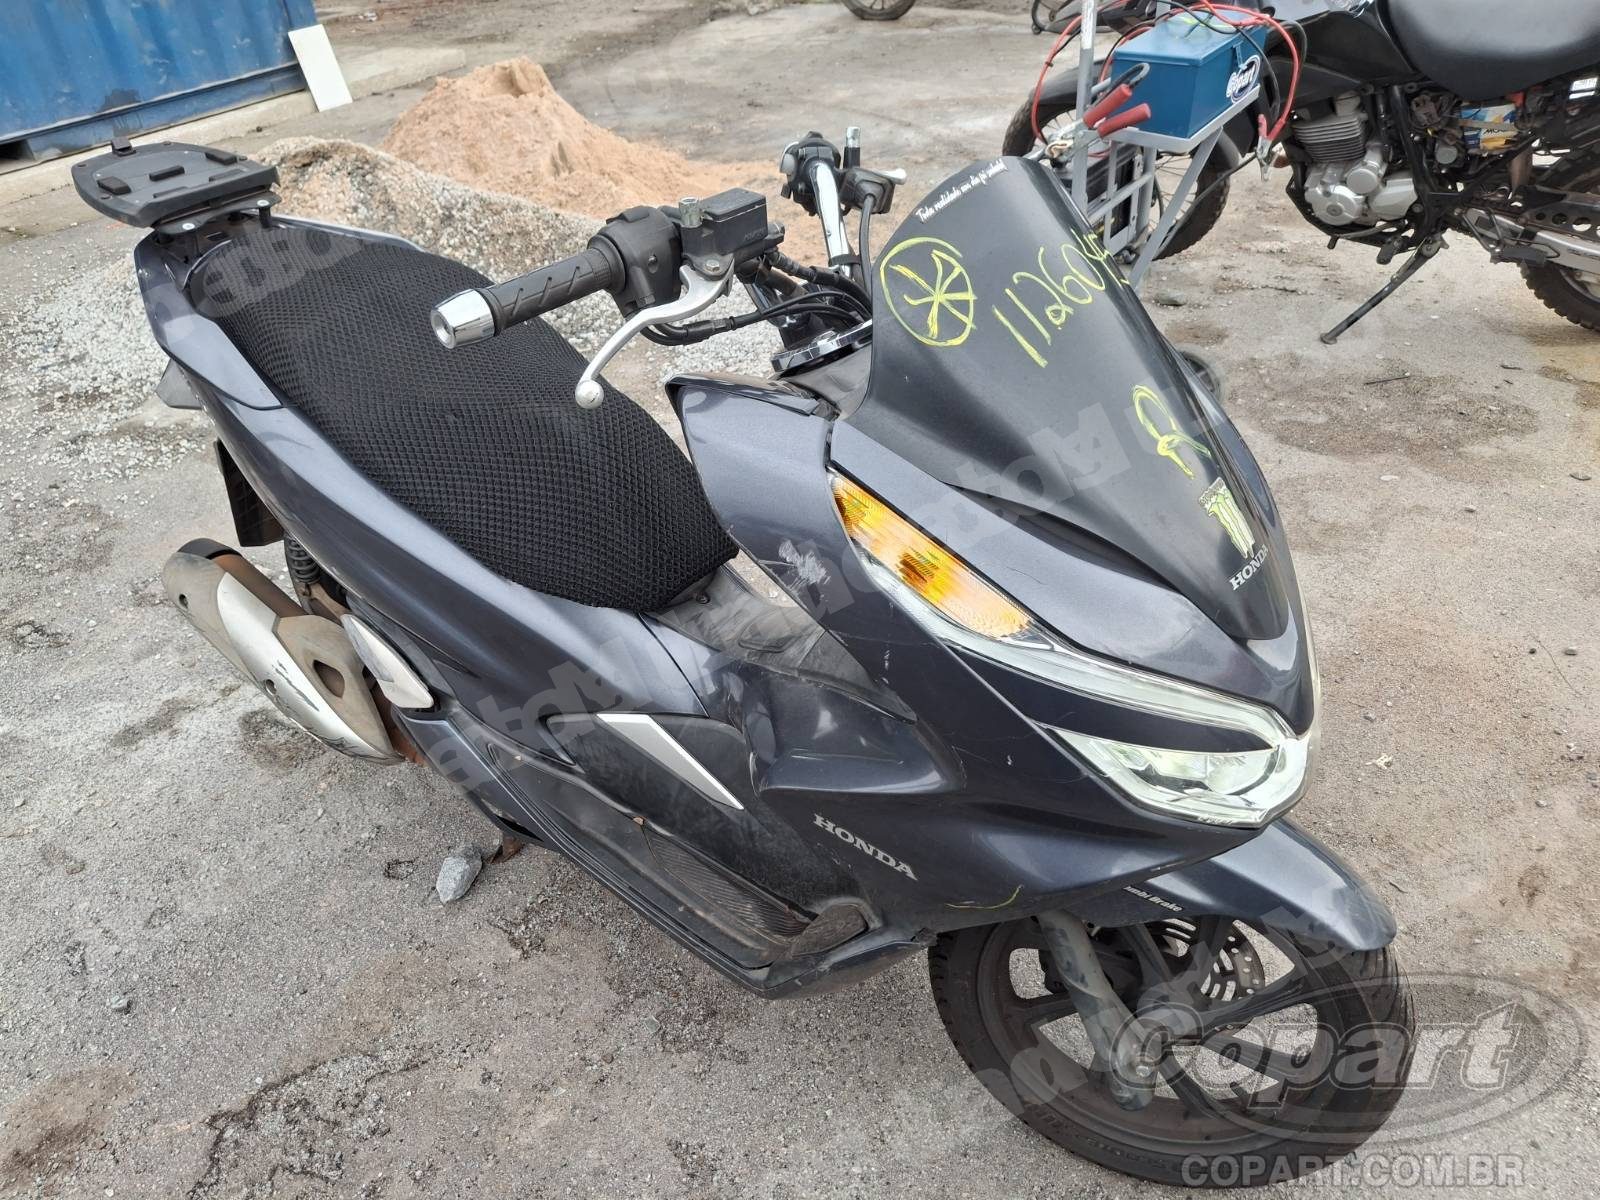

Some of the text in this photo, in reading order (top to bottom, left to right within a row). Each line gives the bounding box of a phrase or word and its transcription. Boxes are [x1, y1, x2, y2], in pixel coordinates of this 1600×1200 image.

[1229, 543, 1269, 591] HONDA
[813, 813, 919, 881] HONDA
[1148, 896, 1183, 911] Brake
